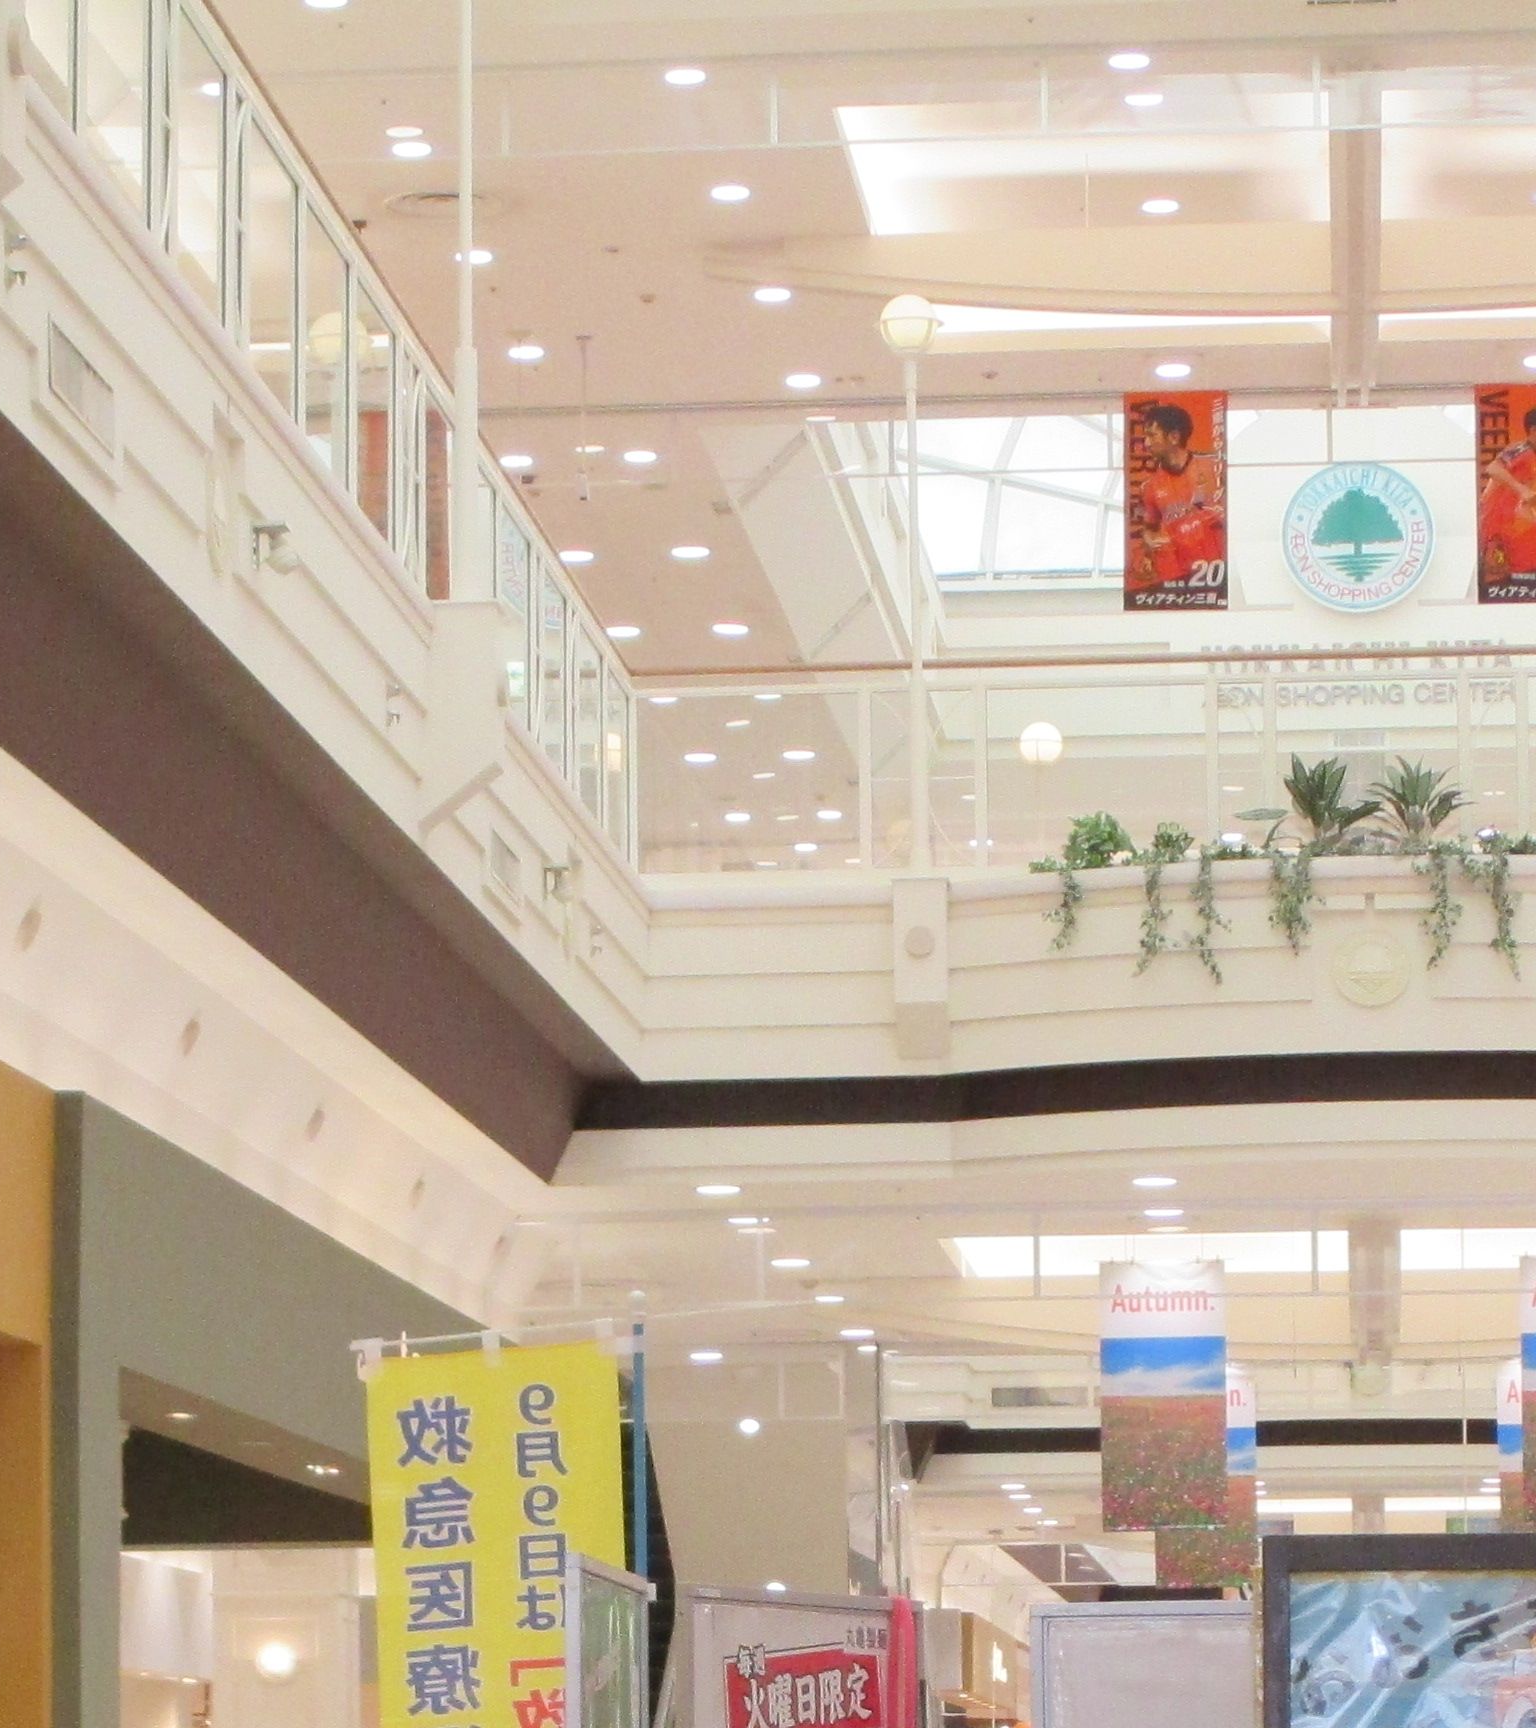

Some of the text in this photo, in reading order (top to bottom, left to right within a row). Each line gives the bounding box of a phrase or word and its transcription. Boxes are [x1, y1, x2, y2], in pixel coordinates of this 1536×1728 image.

[1188, 559, 1225, 587] 20
[1308, 570, 1393, 601] SHOPPING
[1391, 520, 1426, 587] CENTER
[1277, 684, 1404, 707] SHOPPING
[1110, 1284, 1216, 1314] Autumn.
